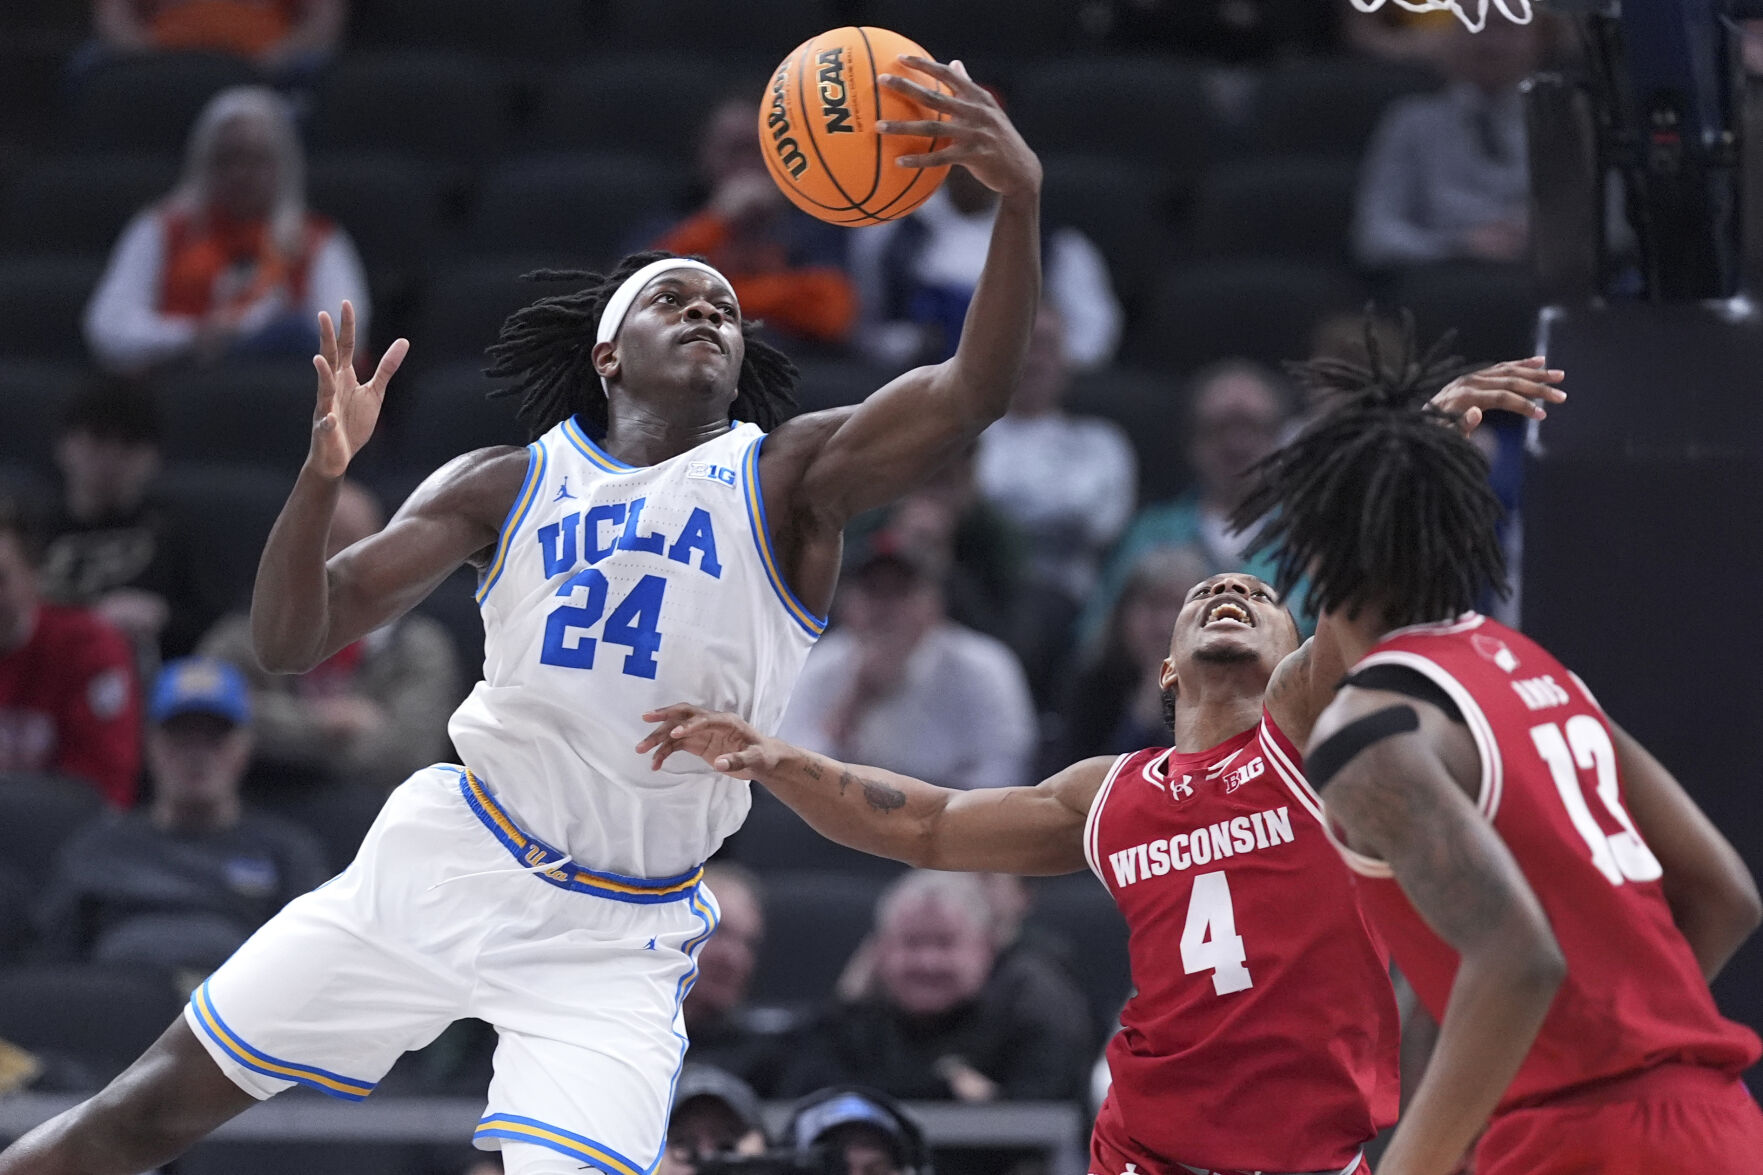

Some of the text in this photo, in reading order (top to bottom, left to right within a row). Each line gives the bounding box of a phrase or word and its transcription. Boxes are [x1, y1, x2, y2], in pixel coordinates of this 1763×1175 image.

[768, 56, 809, 181] Wilson
[815, 47, 854, 134] NCAA
[537, 497, 722, 580] UCLA
[540, 568, 667, 680] 24
[524, 844, 568, 873] Ula
[1108, 806, 1295, 888] WISCONSIN
[1180, 870, 1253, 996] 4
